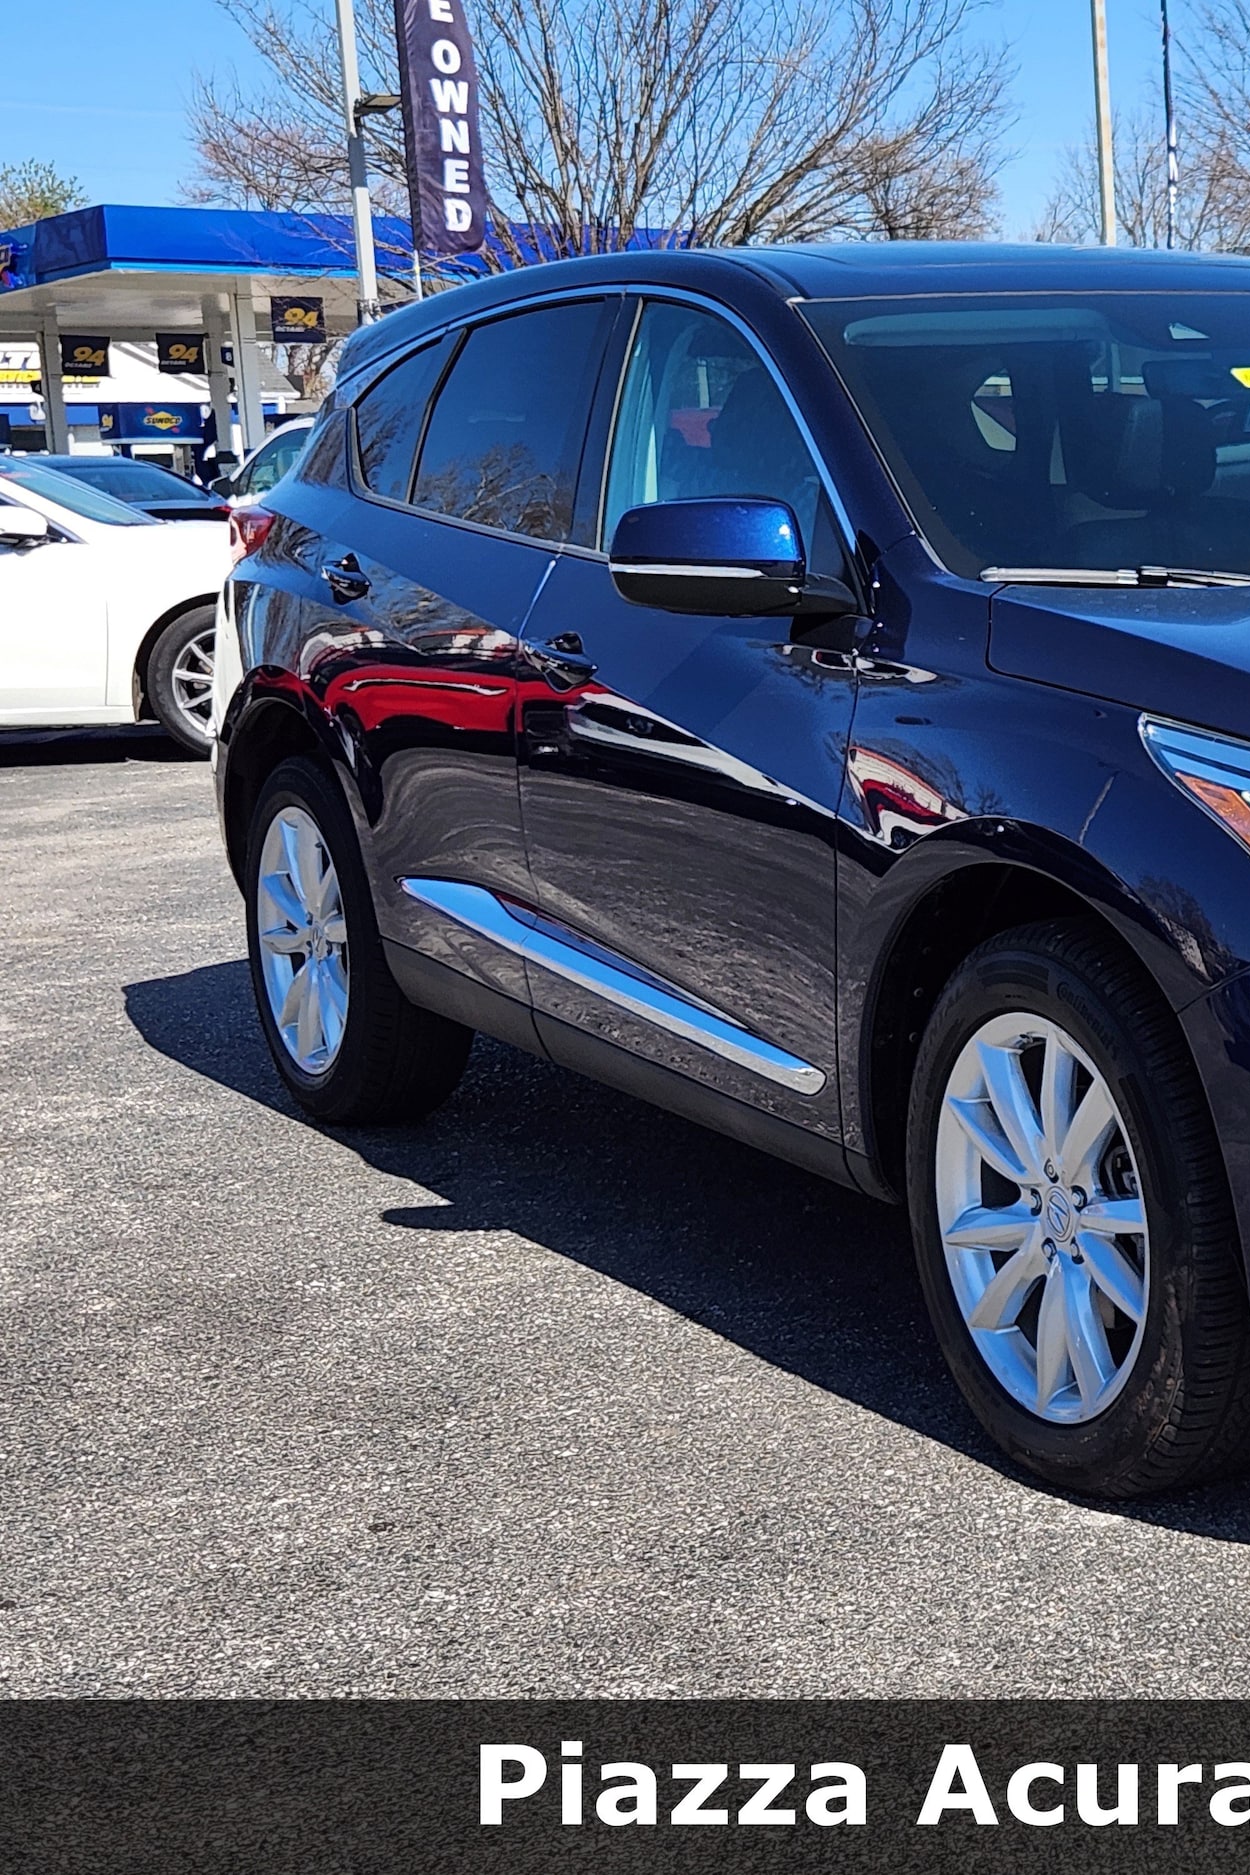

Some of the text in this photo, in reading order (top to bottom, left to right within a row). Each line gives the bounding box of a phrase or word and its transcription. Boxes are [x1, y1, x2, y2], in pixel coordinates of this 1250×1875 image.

[429, 39, 473, 232] OWNED
[284, 307, 319, 328] 94
[73, 346, 106, 366] 94
[169, 343, 199, 363] 94
[145, 416, 182, 425] SUNOCO
